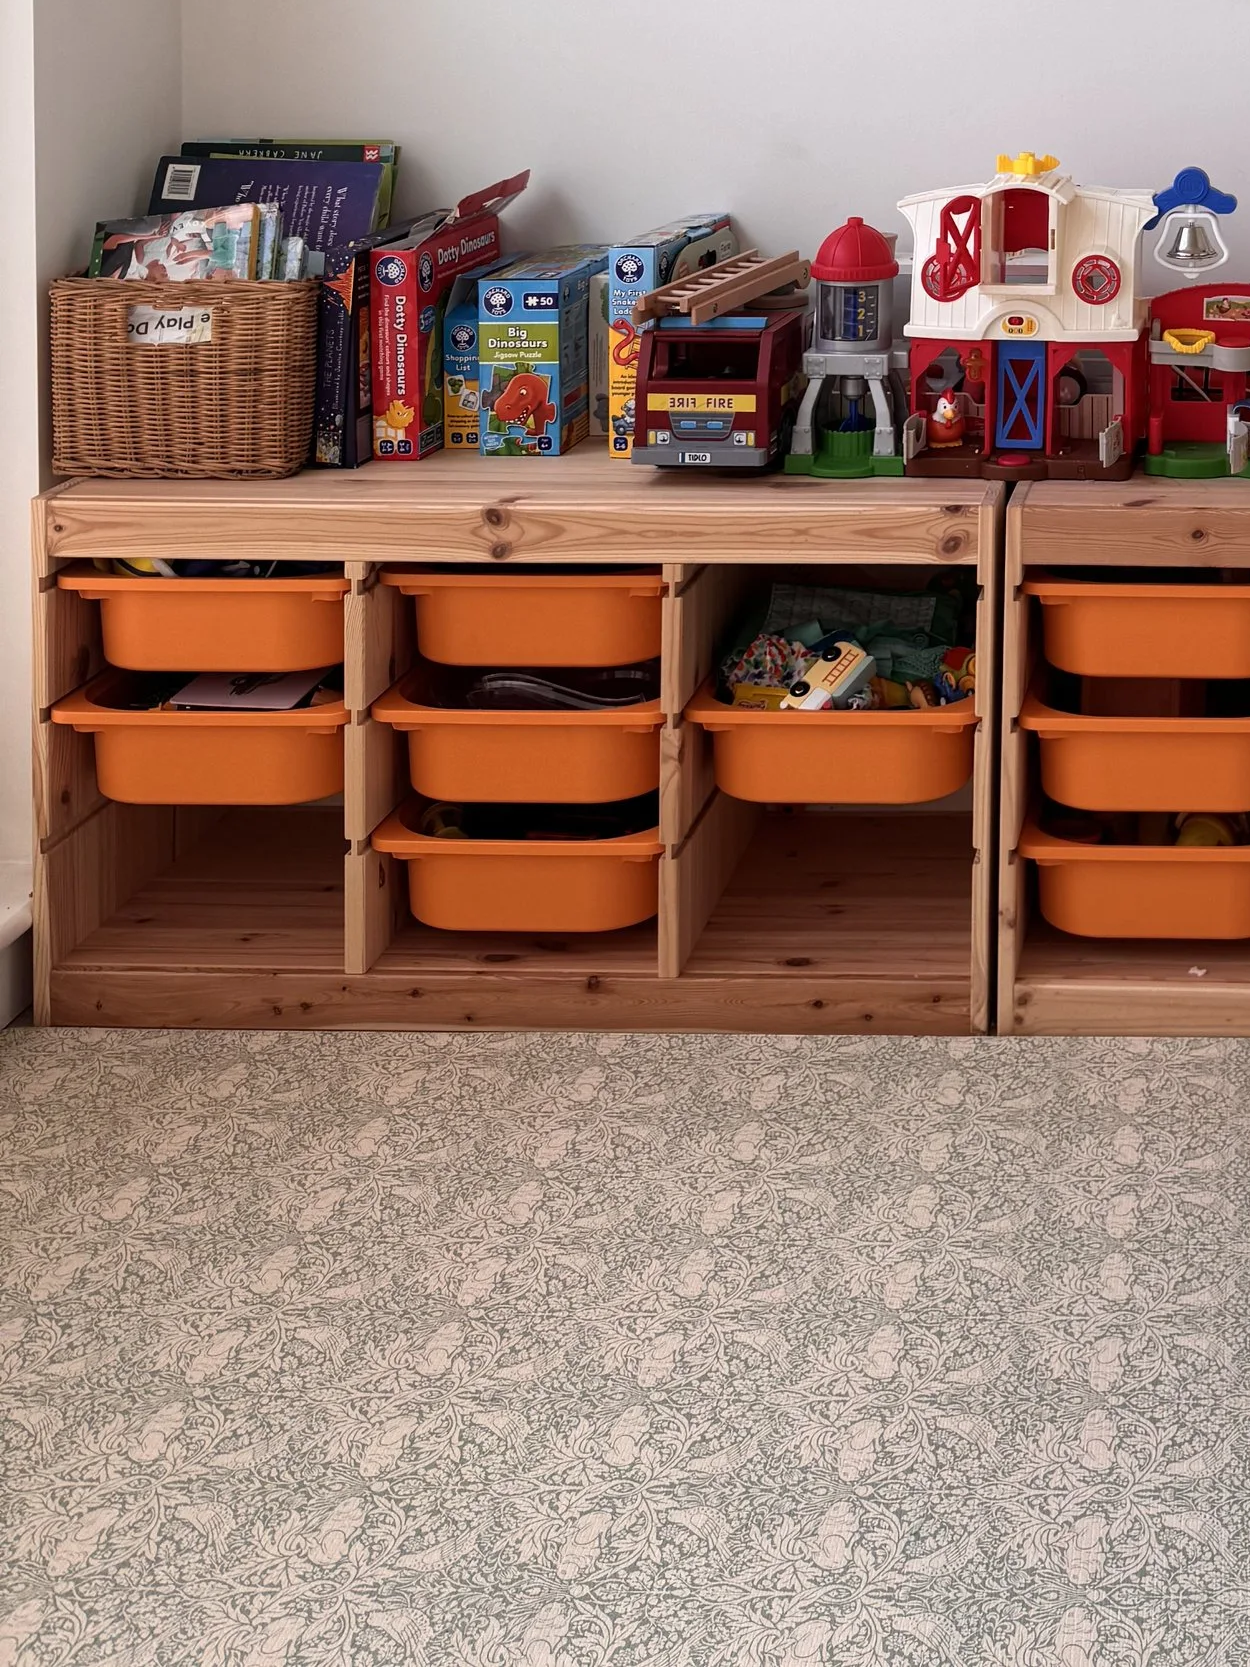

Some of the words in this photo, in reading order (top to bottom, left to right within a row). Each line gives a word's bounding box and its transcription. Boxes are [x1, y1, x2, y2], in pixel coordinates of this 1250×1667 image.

[293, 149, 323, 161] JANE
[322, 185, 333, 205] every
[334, 186, 348, 208] What
[320, 206, 332, 224] child
[329, 209, 340, 228] story
[316, 226, 325, 243] want
[437, 245, 461, 265] Dotty
[460, 231, 496, 254] Dinosaurs
[617, 253, 643, 267] ORCHARD
[393, 258, 406, 284] ORCHARD
[622, 276, 638, 284] TOYS
[485, 286, 511, 300] ORCHARD
[613, 289, 626, 298] My
[627, 289, 646, 298] First
[857, 290, 866, 303] 3
[540, 297, 554, 306] 50
[611, 298, 636, 307] Snake
[393, 295, 407, 331] Dotty
[491, 308, 507, 317] TOYS
[857, 308, 866, 320] 2
[155, 315, 195, 330] Play
[508, 327, 527, 341] Big
[858, 324, 864, 337] 1
[325, 329, 335, 368] PLANETS
[488, 337, 548, 349] Dinosaurs
[493, 351, 519, 360] Jigsaw
[519, 350, 542, 359] Puzzle
[396, 333, 408, 396] Dinosaurs
[455, 364, 471, 372] List
[706, 397, 734, 409] FIRE
[688, 453, 708, 462] TIDLO
